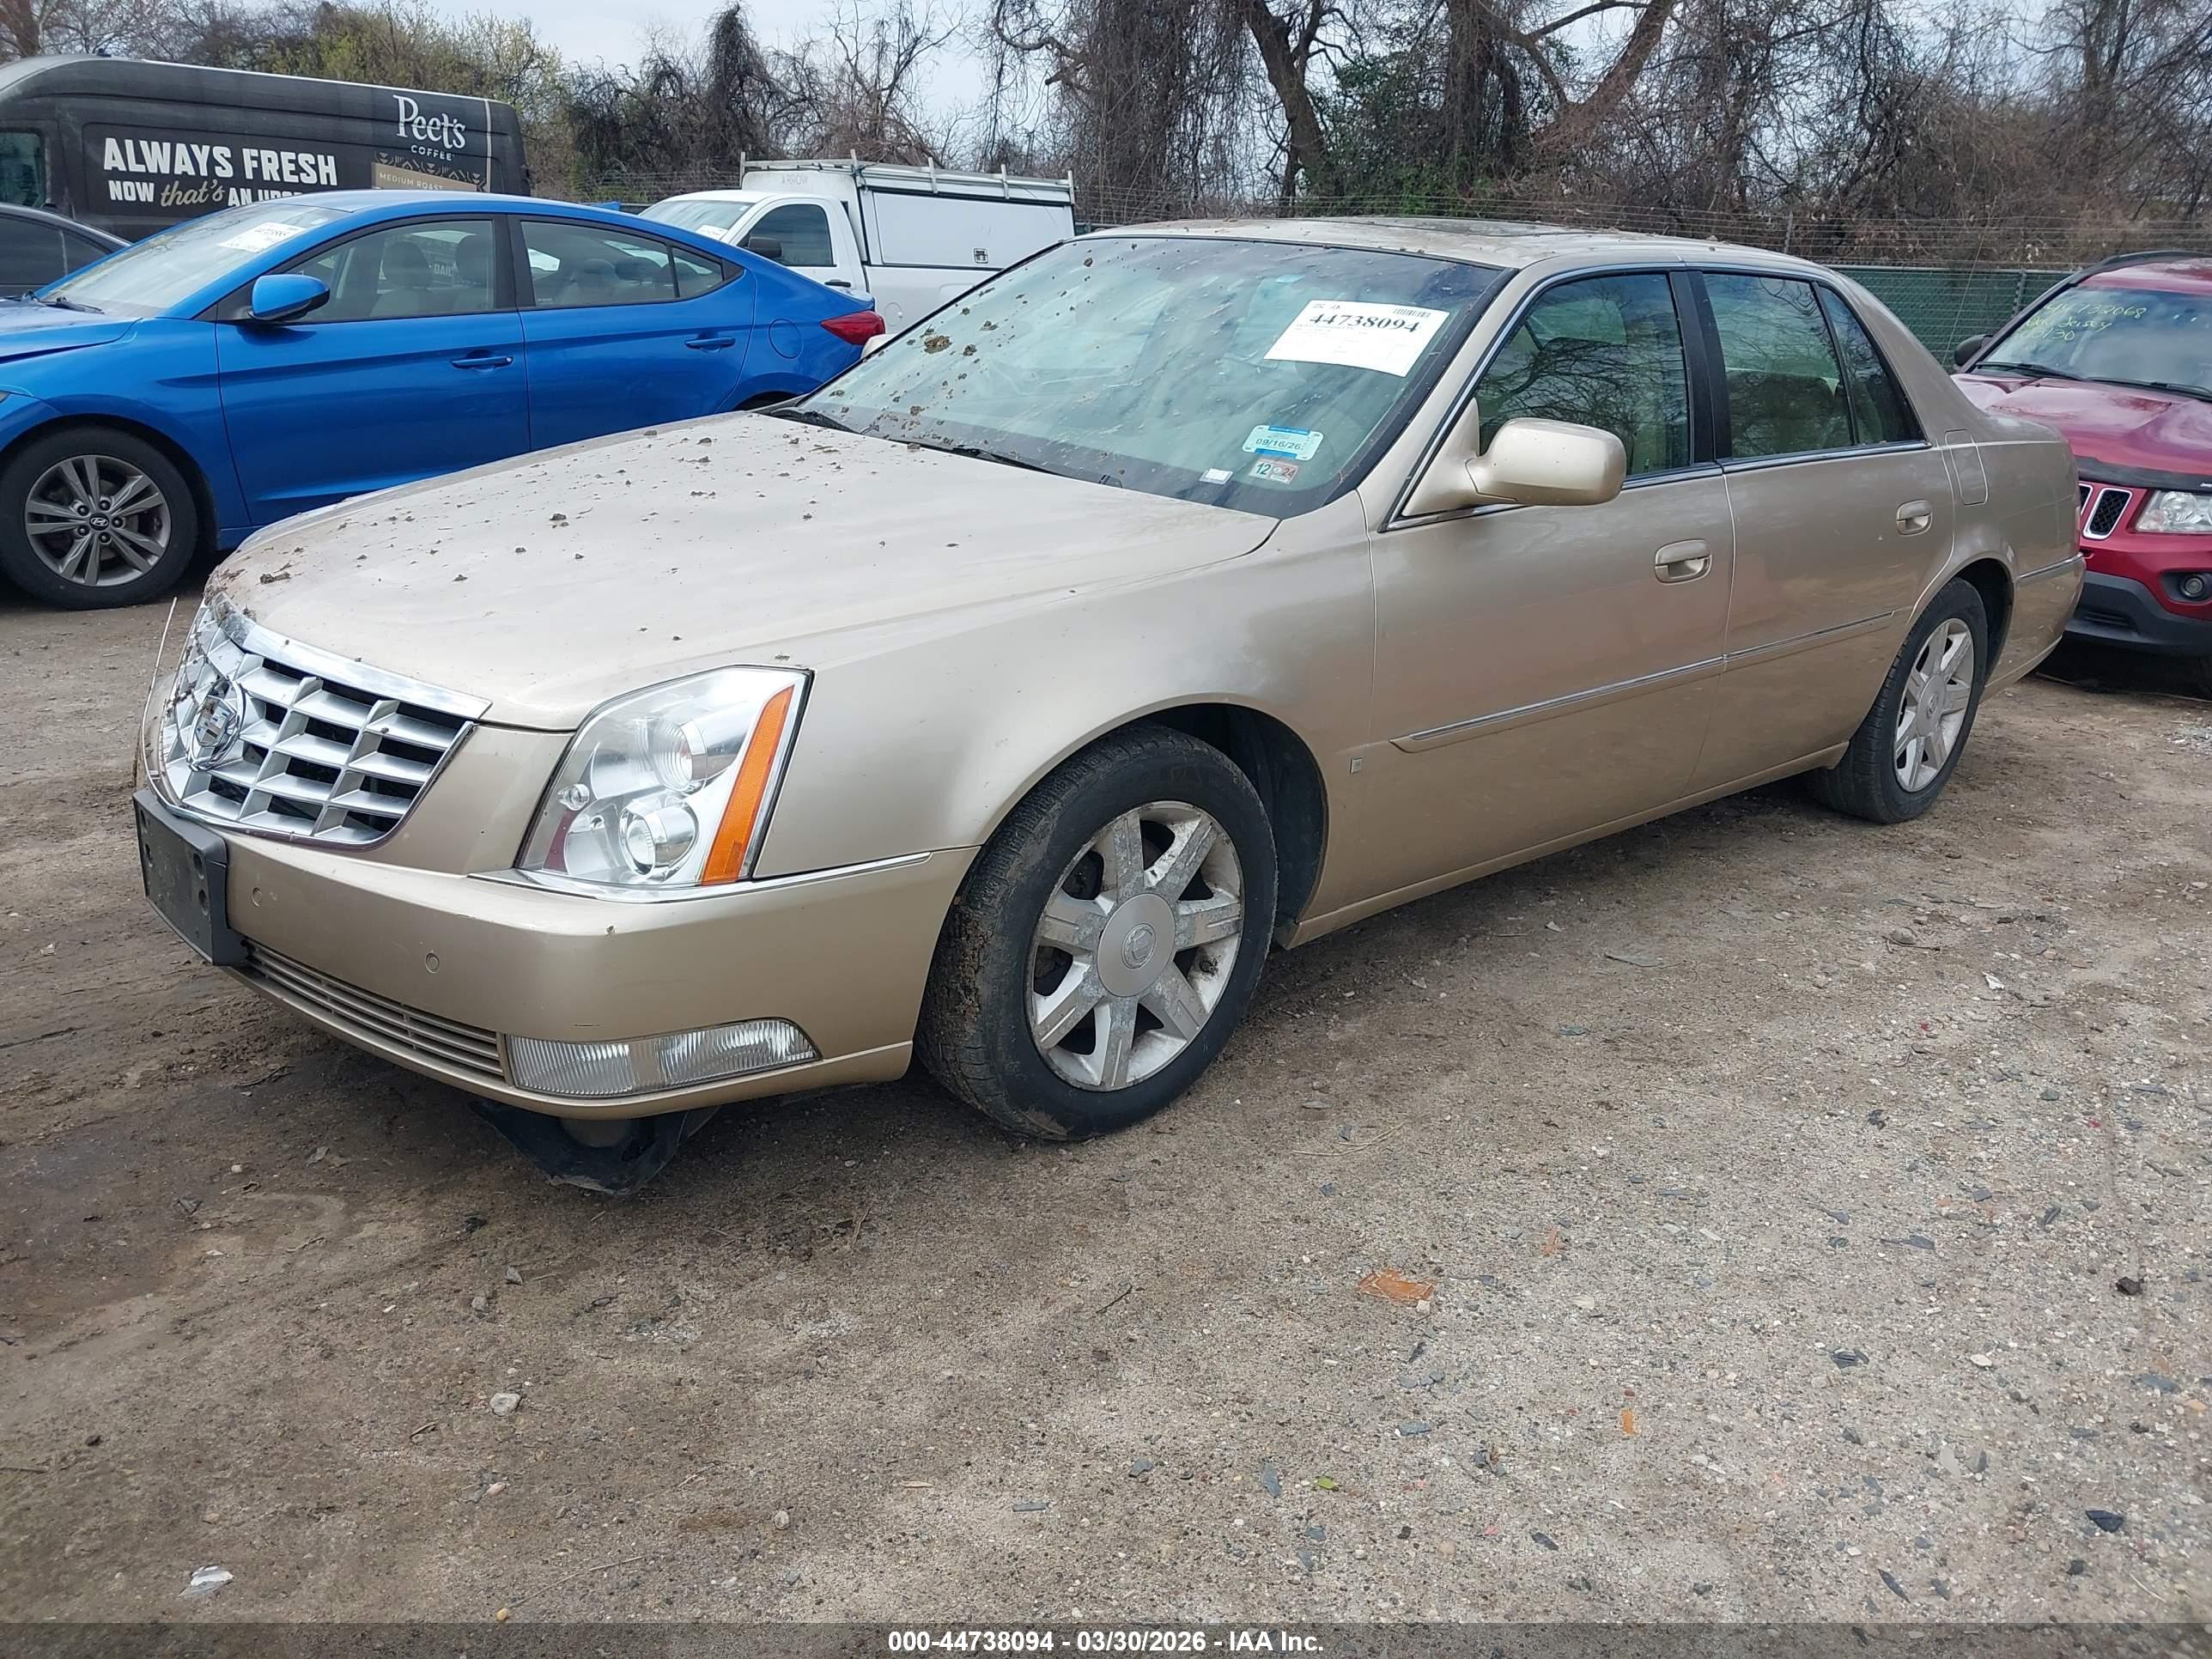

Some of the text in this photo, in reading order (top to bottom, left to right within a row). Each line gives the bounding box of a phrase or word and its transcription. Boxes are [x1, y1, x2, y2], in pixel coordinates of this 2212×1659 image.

[392, 94, 466, 149] Peet's
[103, 137, 338, 186] ALWAYS FRESH
[410, 144, 453, 161] COFFEE
[380, 172, 414, 186] MEDIUM
[108, 179, 155, 203] NOW
[161, 179, 226, 207] that's
[228, 186, 252, 207] AN
[1310, 313, 1420, 333] 44738094
[1256, 462, 1271, 475] 12
